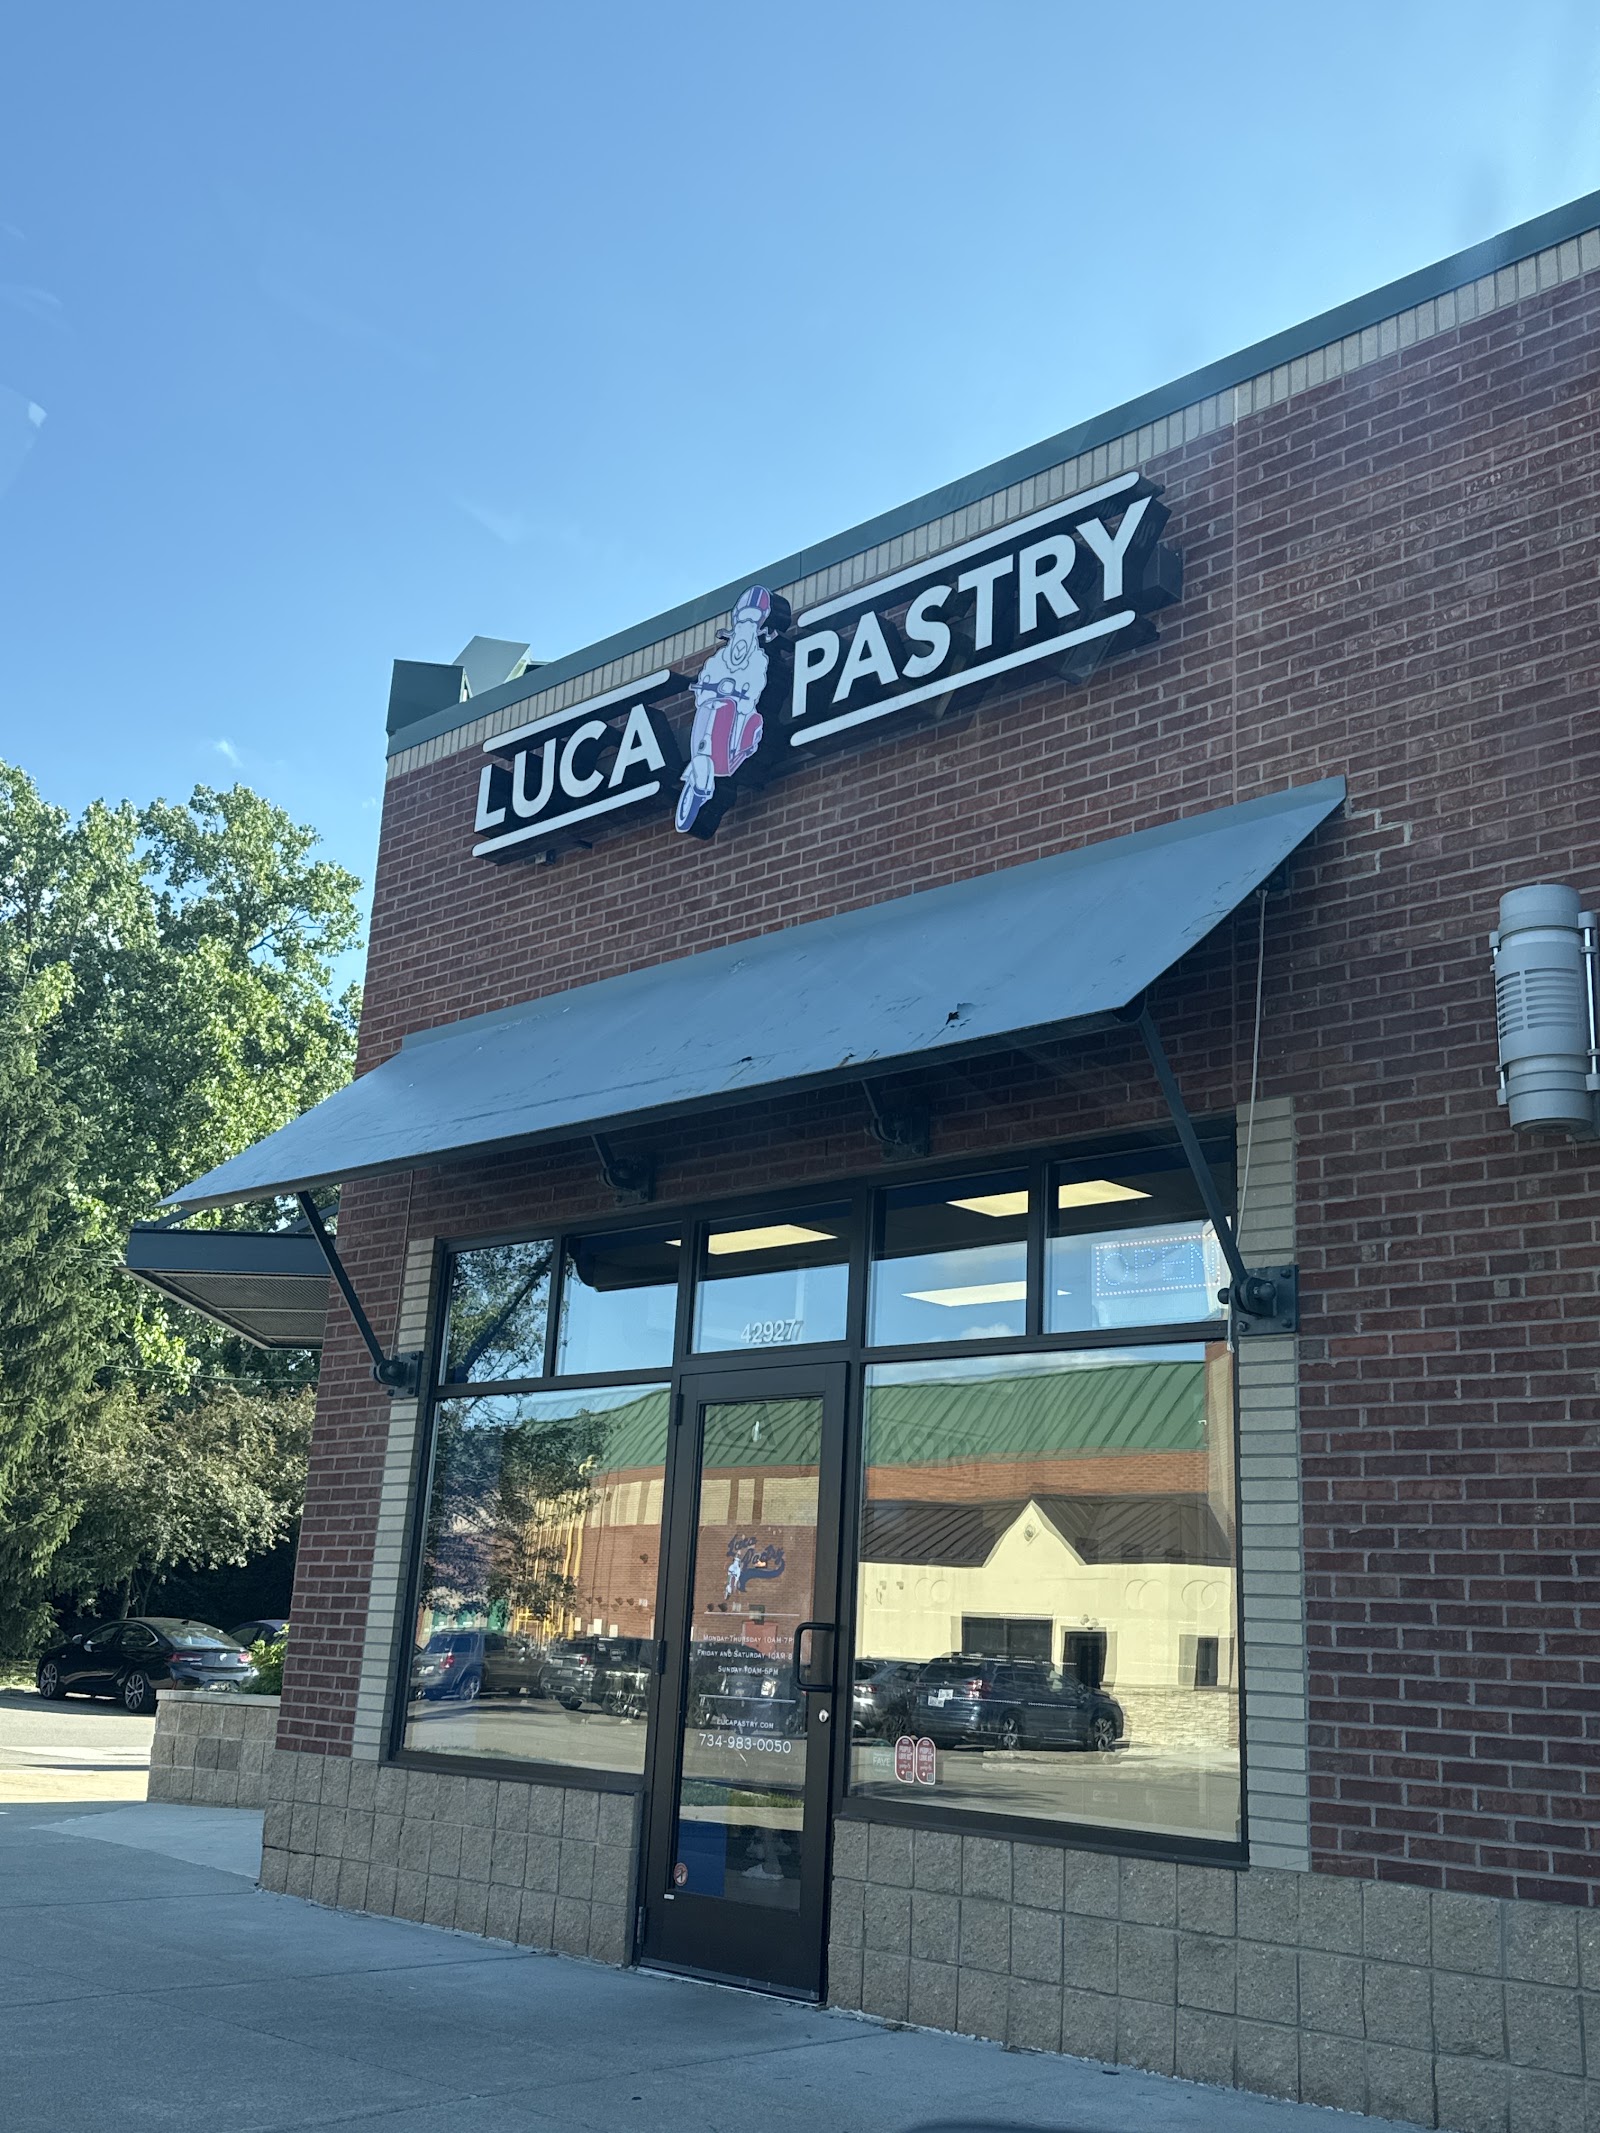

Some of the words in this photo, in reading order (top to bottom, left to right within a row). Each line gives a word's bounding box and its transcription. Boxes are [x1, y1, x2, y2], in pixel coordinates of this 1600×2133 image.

[474, 704, 666, 833] LUCA
[790, 495, 1153, 718] PASTRY
[1102, 1243, 1215, 1286] OPEN
[741, 1319, 796, 1343] 42927
[764, 1636, 795, 1644] 10AM-7P
[699, 1733, 792, 1754] 734-983-0050
[872, 1756, 891, 1767] FAVE
